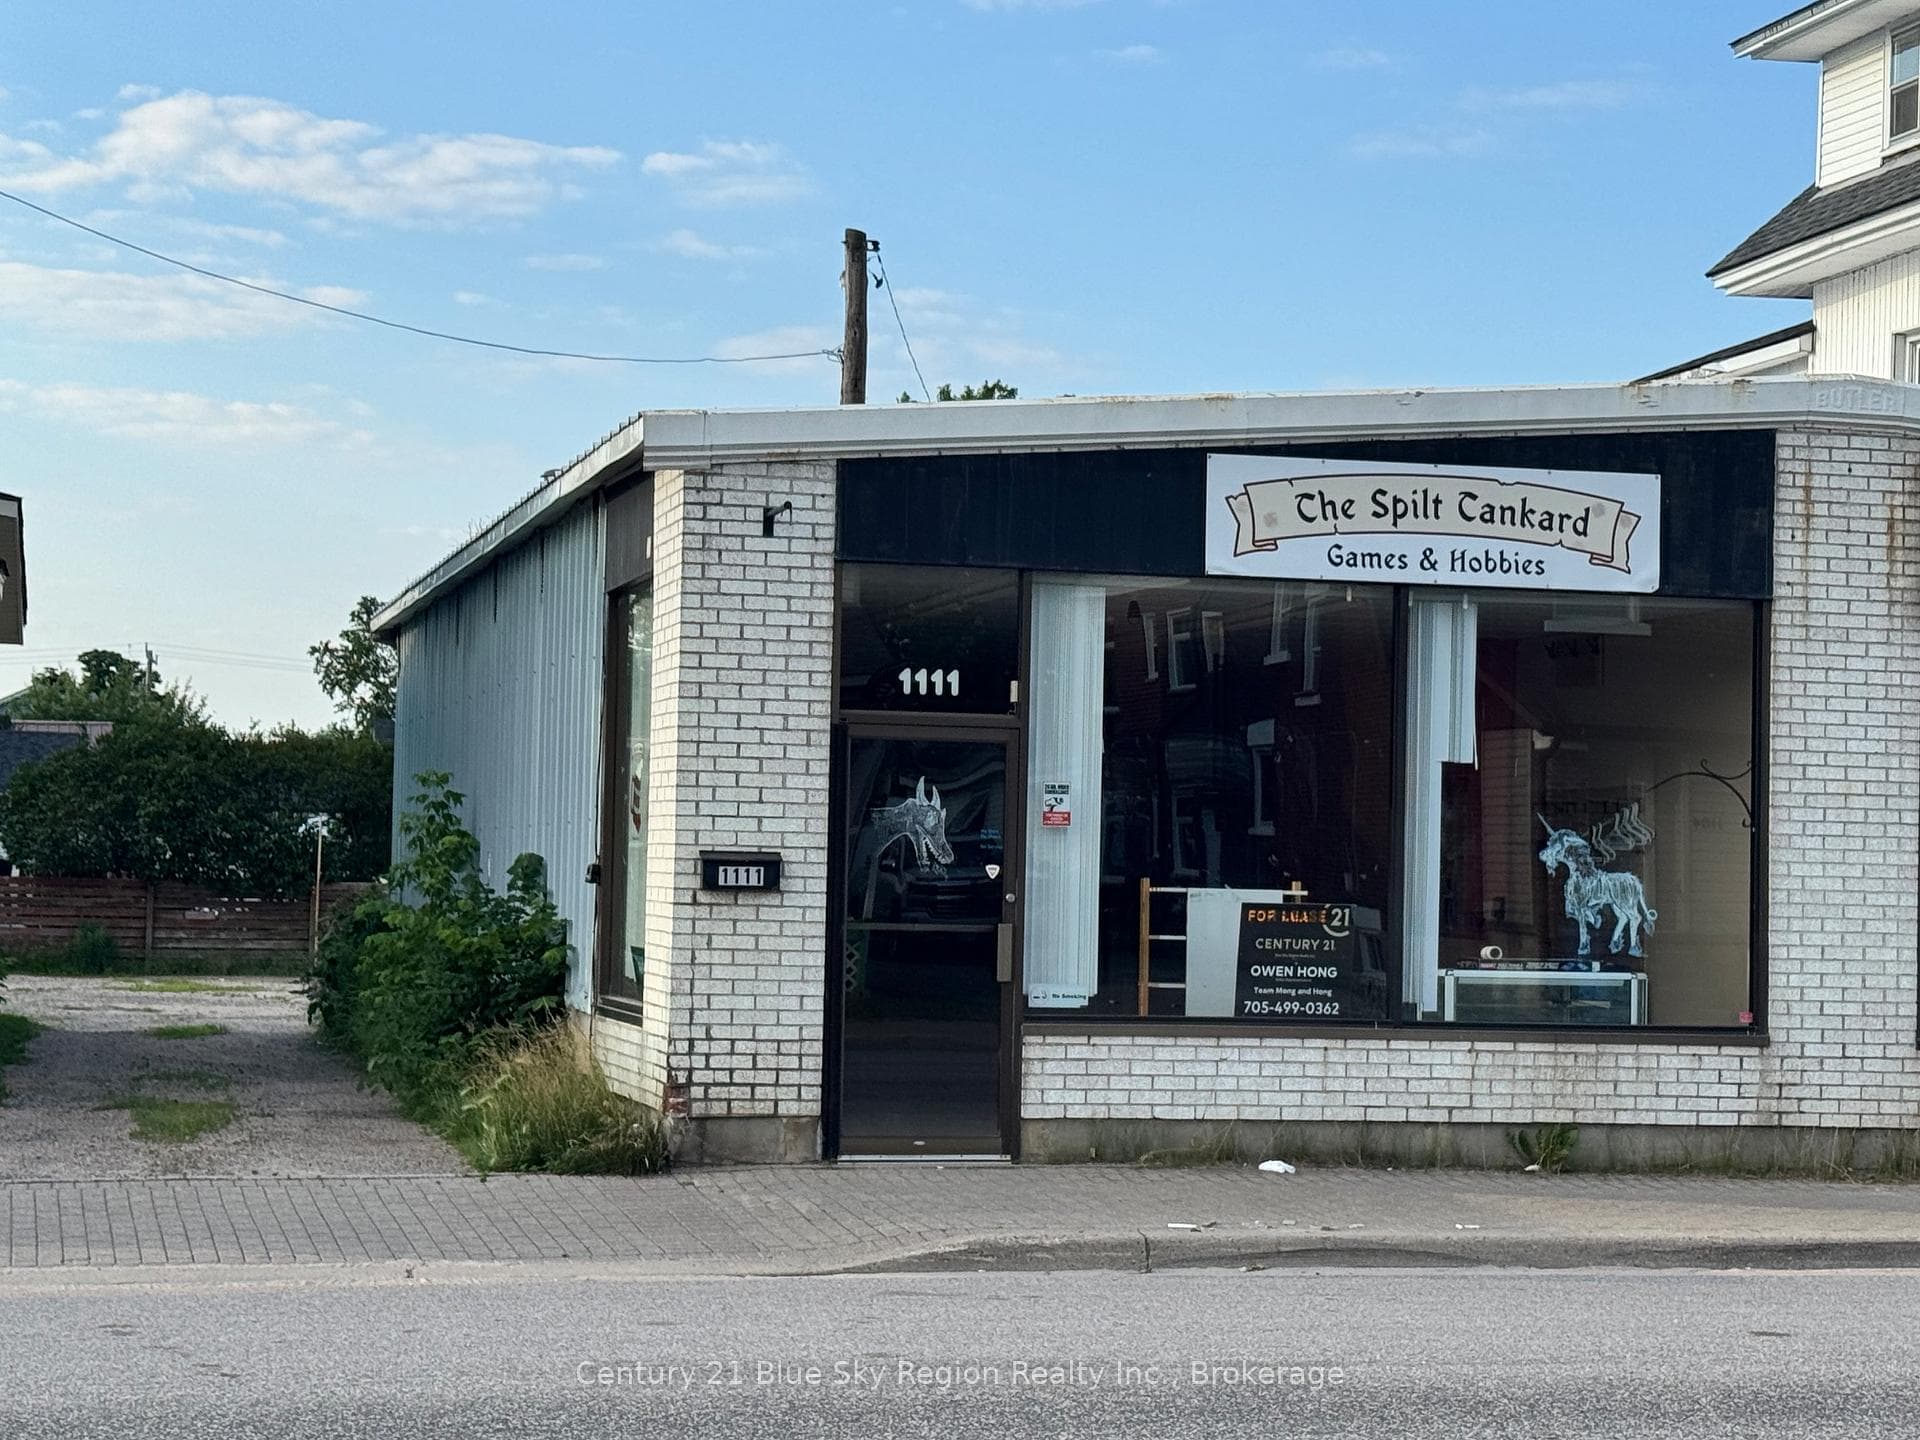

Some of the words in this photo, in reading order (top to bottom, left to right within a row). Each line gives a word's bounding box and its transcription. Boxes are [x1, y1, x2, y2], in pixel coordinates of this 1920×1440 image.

[1295, 490, 1355, 523] The
[1371, 488, 1443, 528] Spilt
[1458, 491, 1591, 537] Tankard
[1327, 544, 1408, 569] Games
[1419, 547, 1438, 571] &
[1450, 549, 1545, 575] Hobbies
[898, 667, 959, 696] 1111
[722, 867, 762, 885] 1111
[1247, 909, 1276, 922] FOR
[1330, 908, 1350, 926] 21
[1255, 938, 1320, 951] CENTURY
[1323, 939, 1335, 951] 21
[1250, 965, 1294, 977] OWEN
[1297, 966, 1338, 978] HONG
[1313, 988, 1332, 997] Hong
[1244, 1001, 1339, 1015] 705-499-0362
